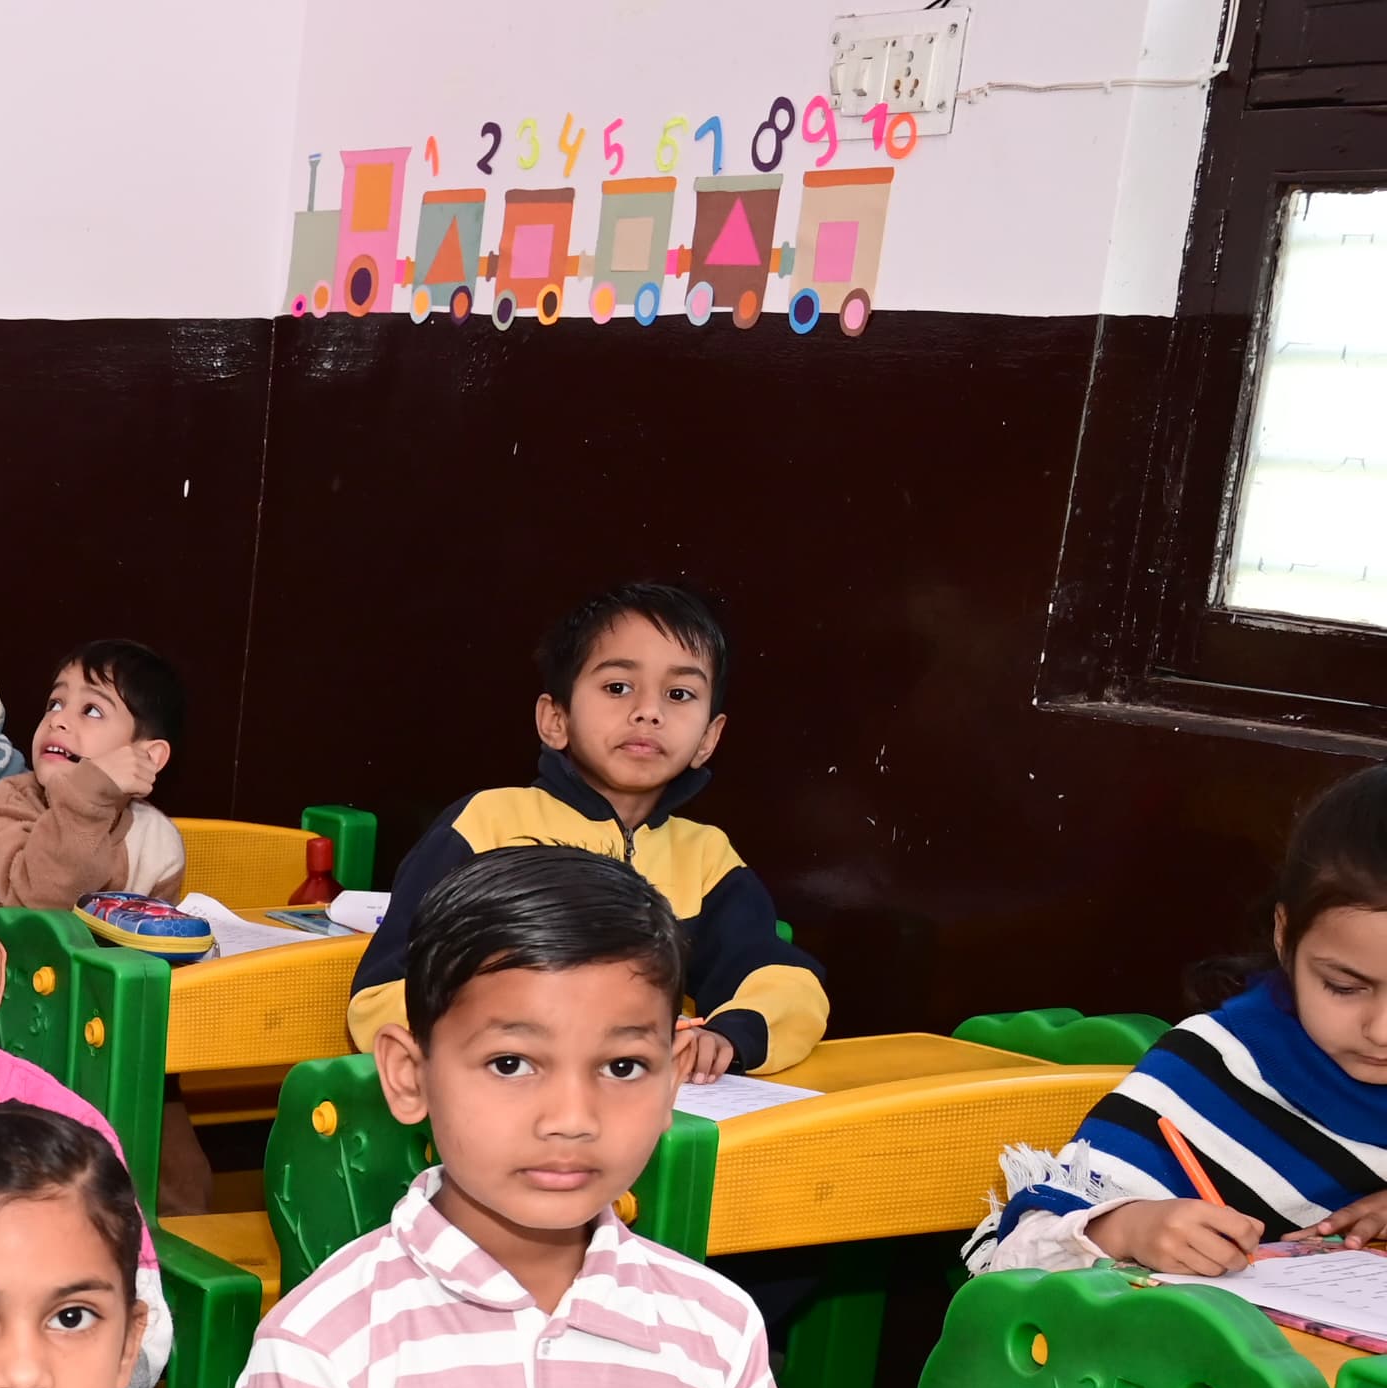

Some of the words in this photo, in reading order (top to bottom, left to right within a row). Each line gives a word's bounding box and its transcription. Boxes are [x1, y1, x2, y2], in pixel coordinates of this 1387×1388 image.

[425, 136, 439, 176] 1
[477, 121, 502, 174] 2
[517, 118, 540, 169] 3
[559, 112, 585, 177] 4
[604, 118, 624, 175] 5
[655, 116, 688, 172] 6
[695, 115, 723, 175] 7
[752, 97, 795, 172] 8
[802, 96, 838, 166] 9
[861, 102, 917, 159] 10
